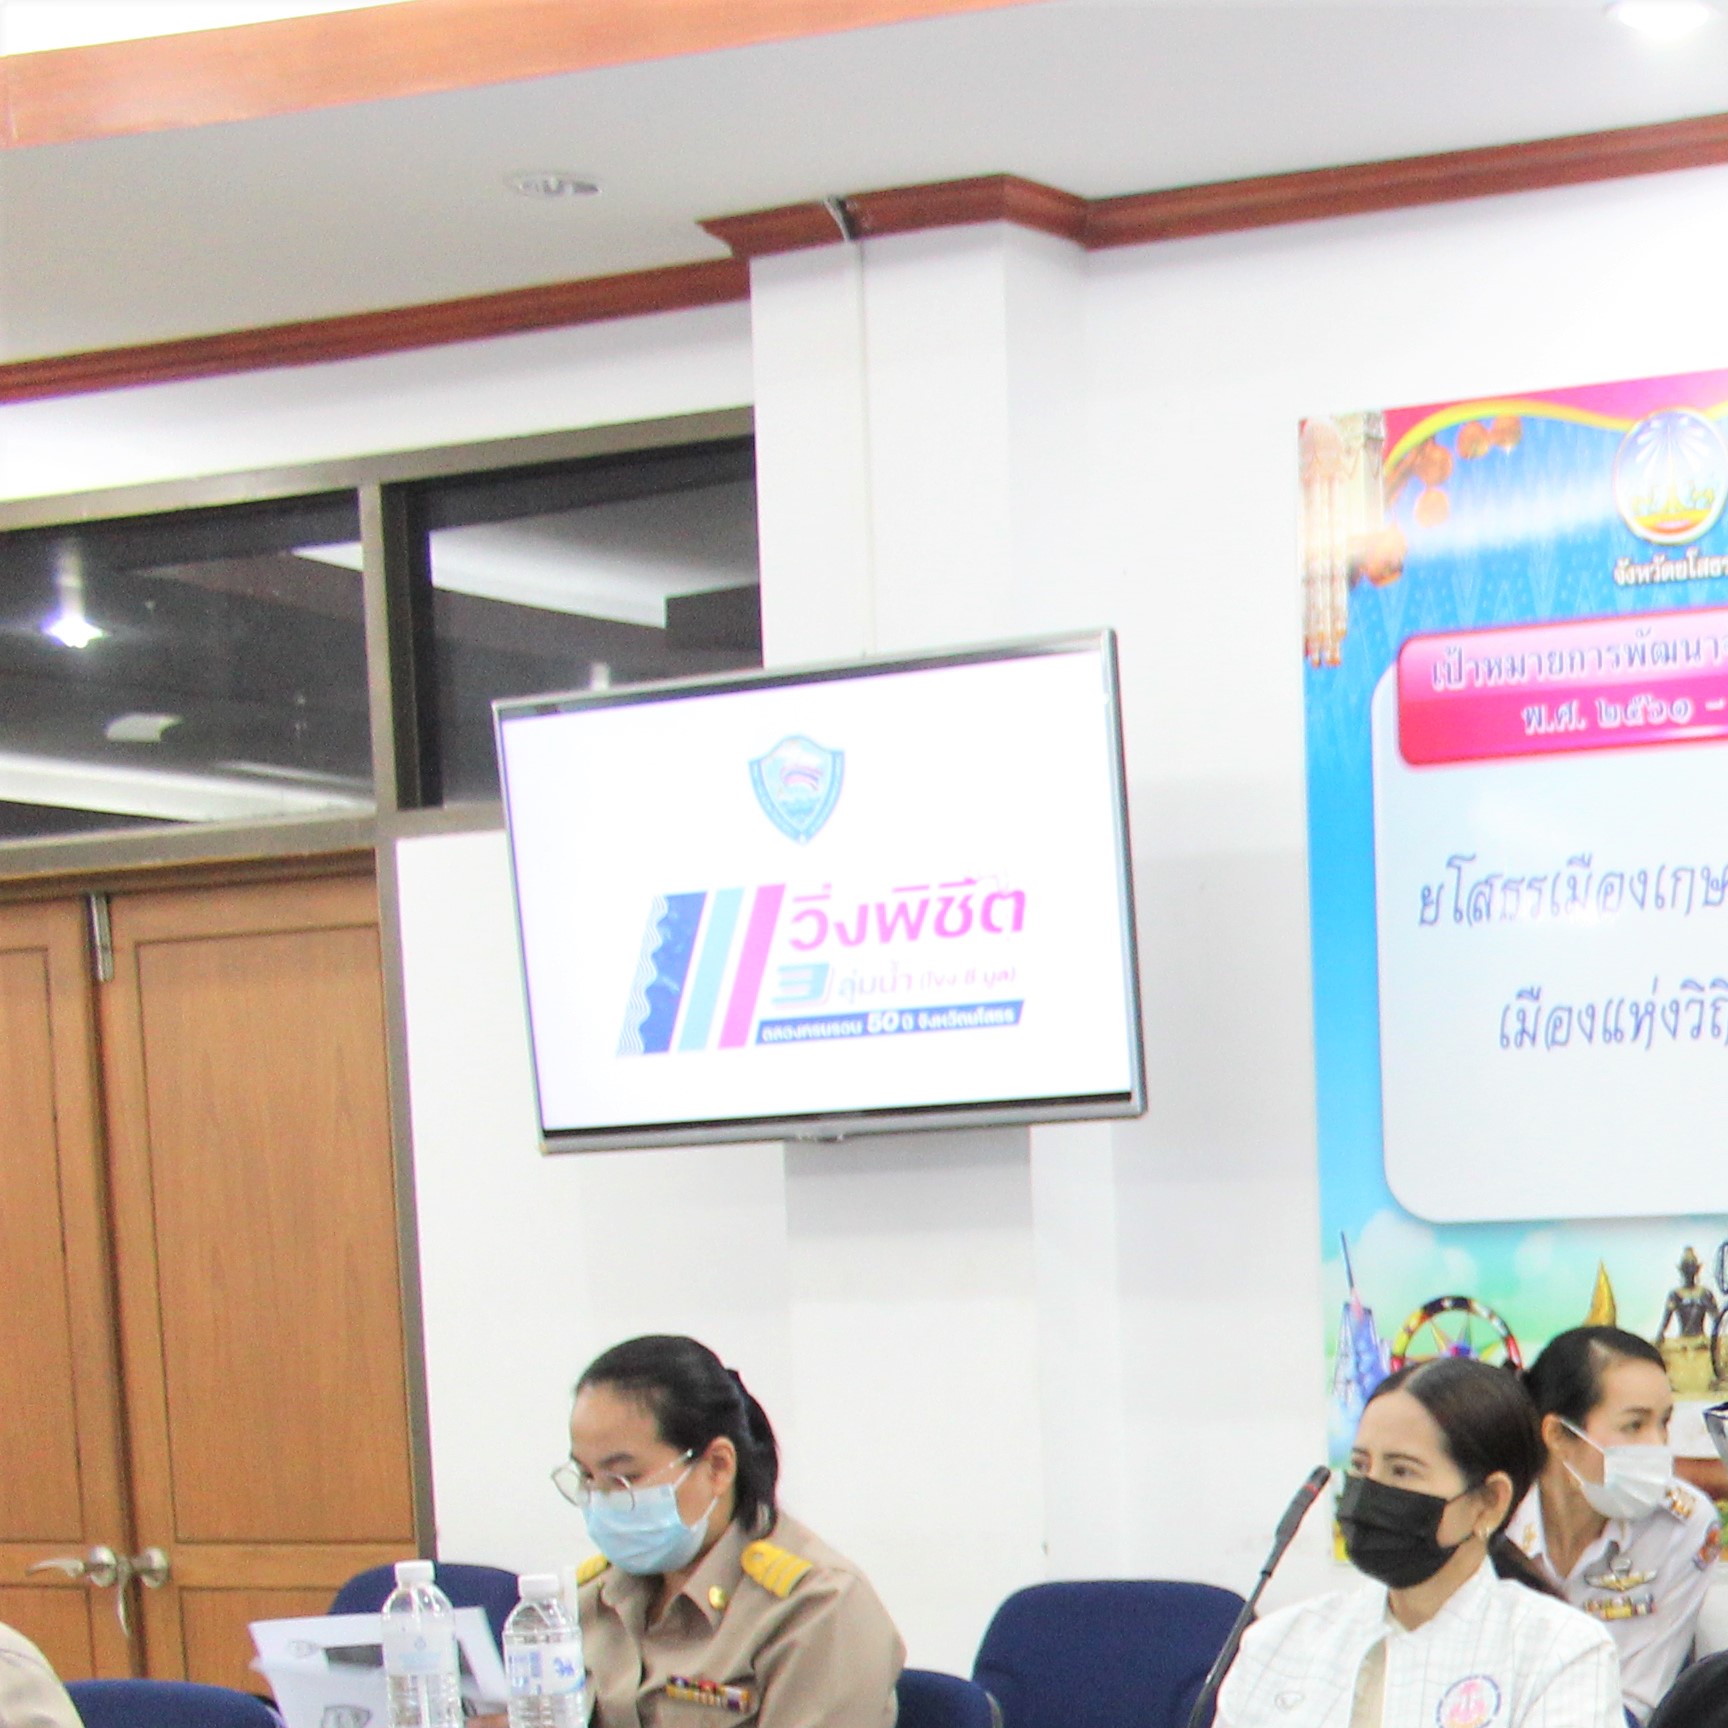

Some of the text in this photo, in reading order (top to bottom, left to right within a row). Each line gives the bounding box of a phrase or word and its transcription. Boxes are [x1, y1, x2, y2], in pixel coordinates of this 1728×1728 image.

[1522, 698, 1587, 737] พ.ศ.
[1597, 690, 1690, 731] ๒๕๖๑
[789, 876, 1026, 951] วิ่งพิชิต
[868, 1011, 900, 1033] 50
